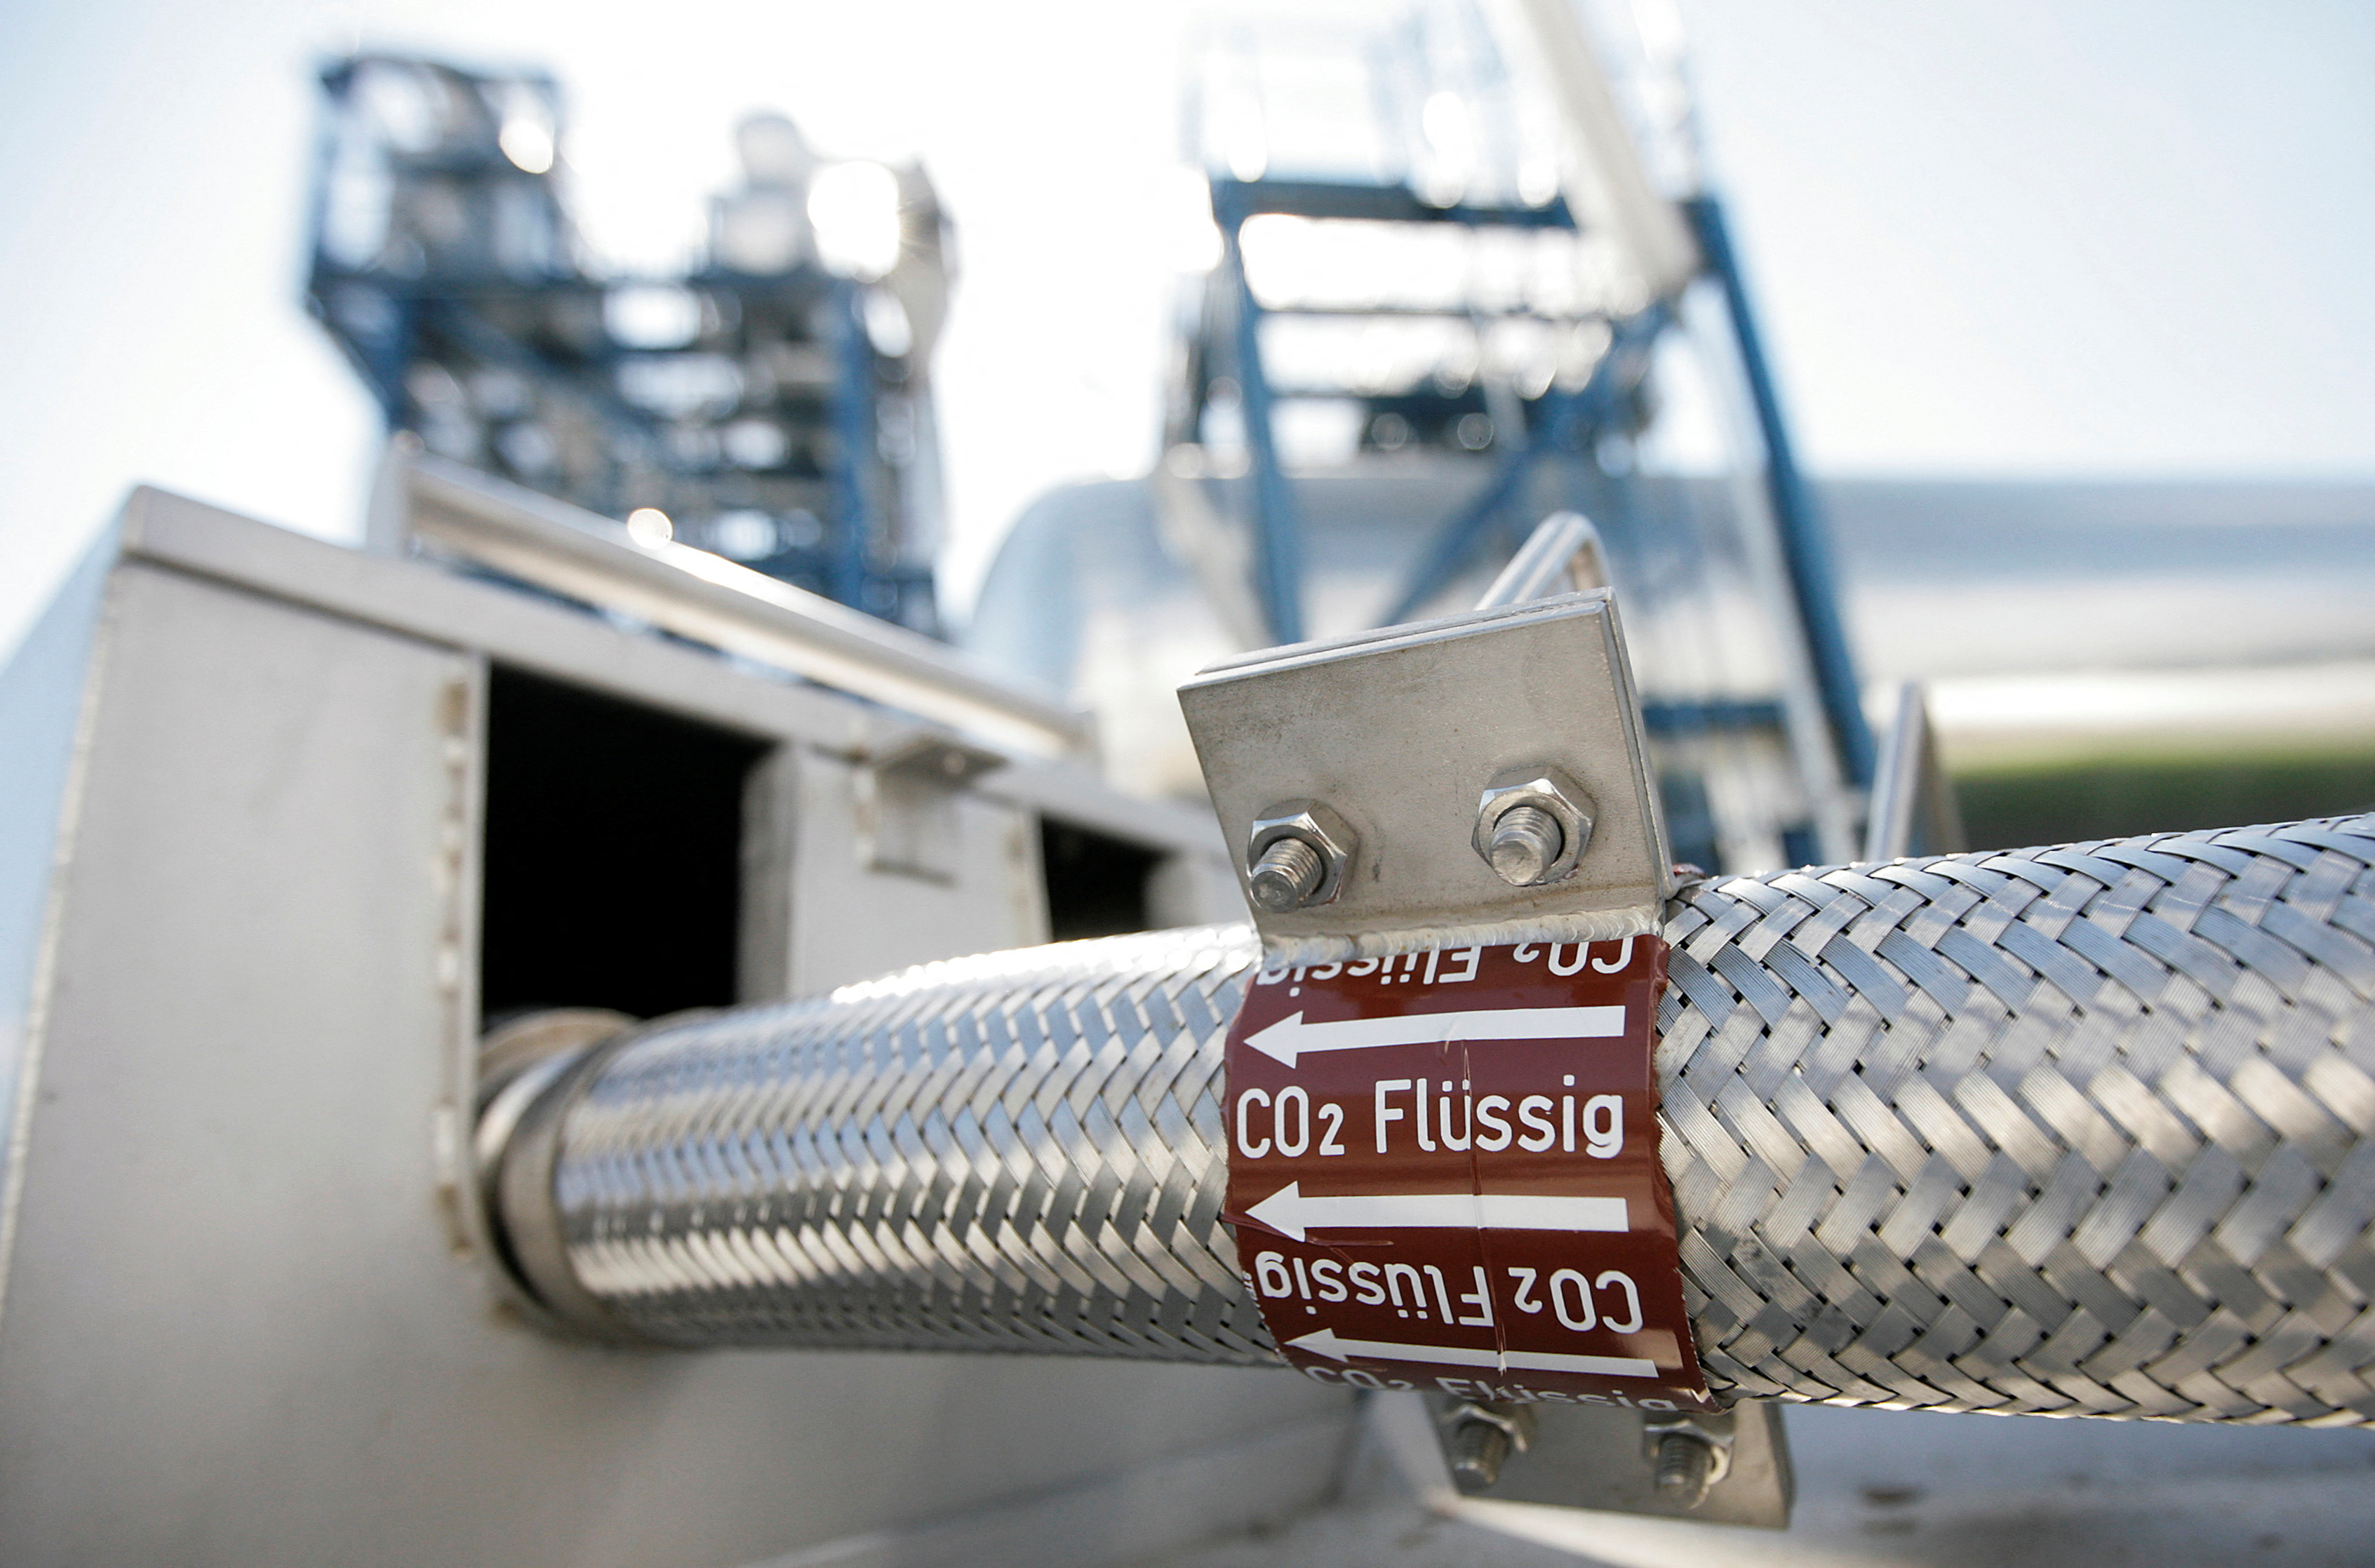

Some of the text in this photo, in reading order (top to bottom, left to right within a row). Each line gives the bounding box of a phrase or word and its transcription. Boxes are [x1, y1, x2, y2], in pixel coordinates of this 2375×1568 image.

[1236, 1074, 1624, 1159] CO2 Flüssig
[1255, 1250, 1494, 1327] Flüssig
[1508, 1266, 1645, 1334] CO2
